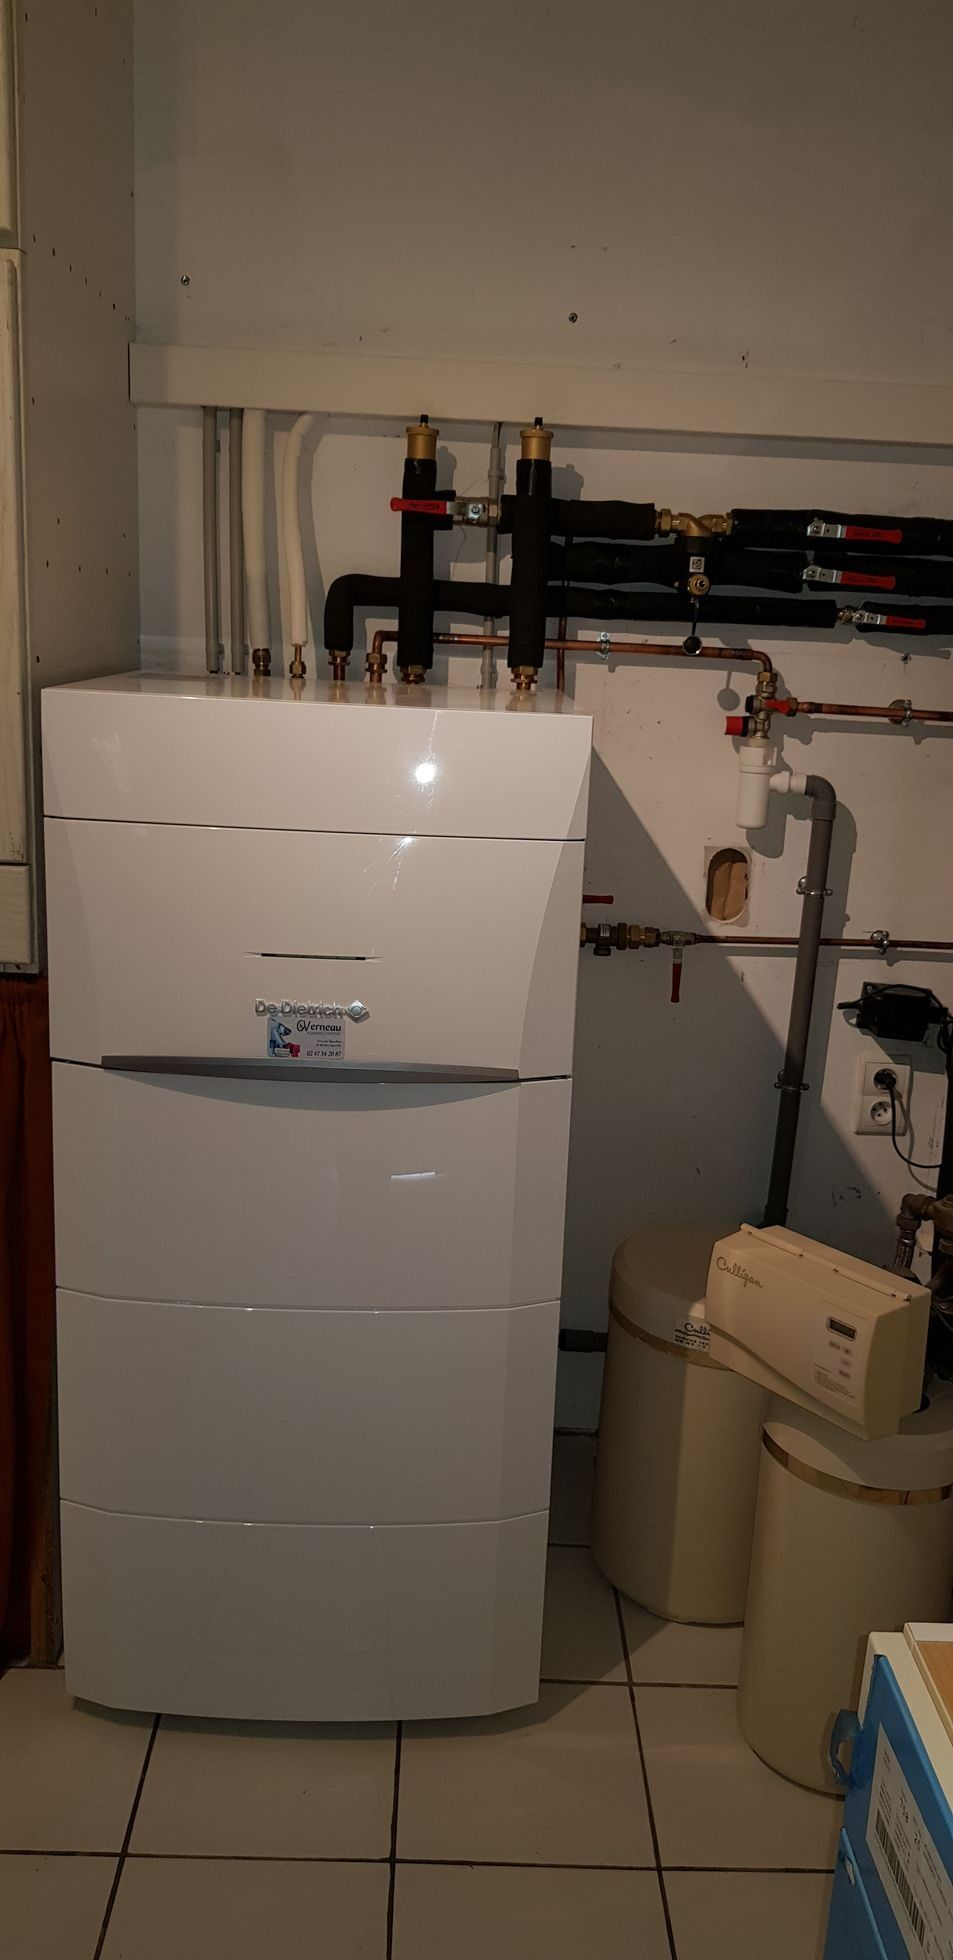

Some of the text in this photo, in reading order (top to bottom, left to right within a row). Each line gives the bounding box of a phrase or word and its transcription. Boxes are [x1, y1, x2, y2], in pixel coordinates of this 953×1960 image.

[255, 999, 343, 1016] De Dietrich
[716, 1256, 764, 1288] Culligan
